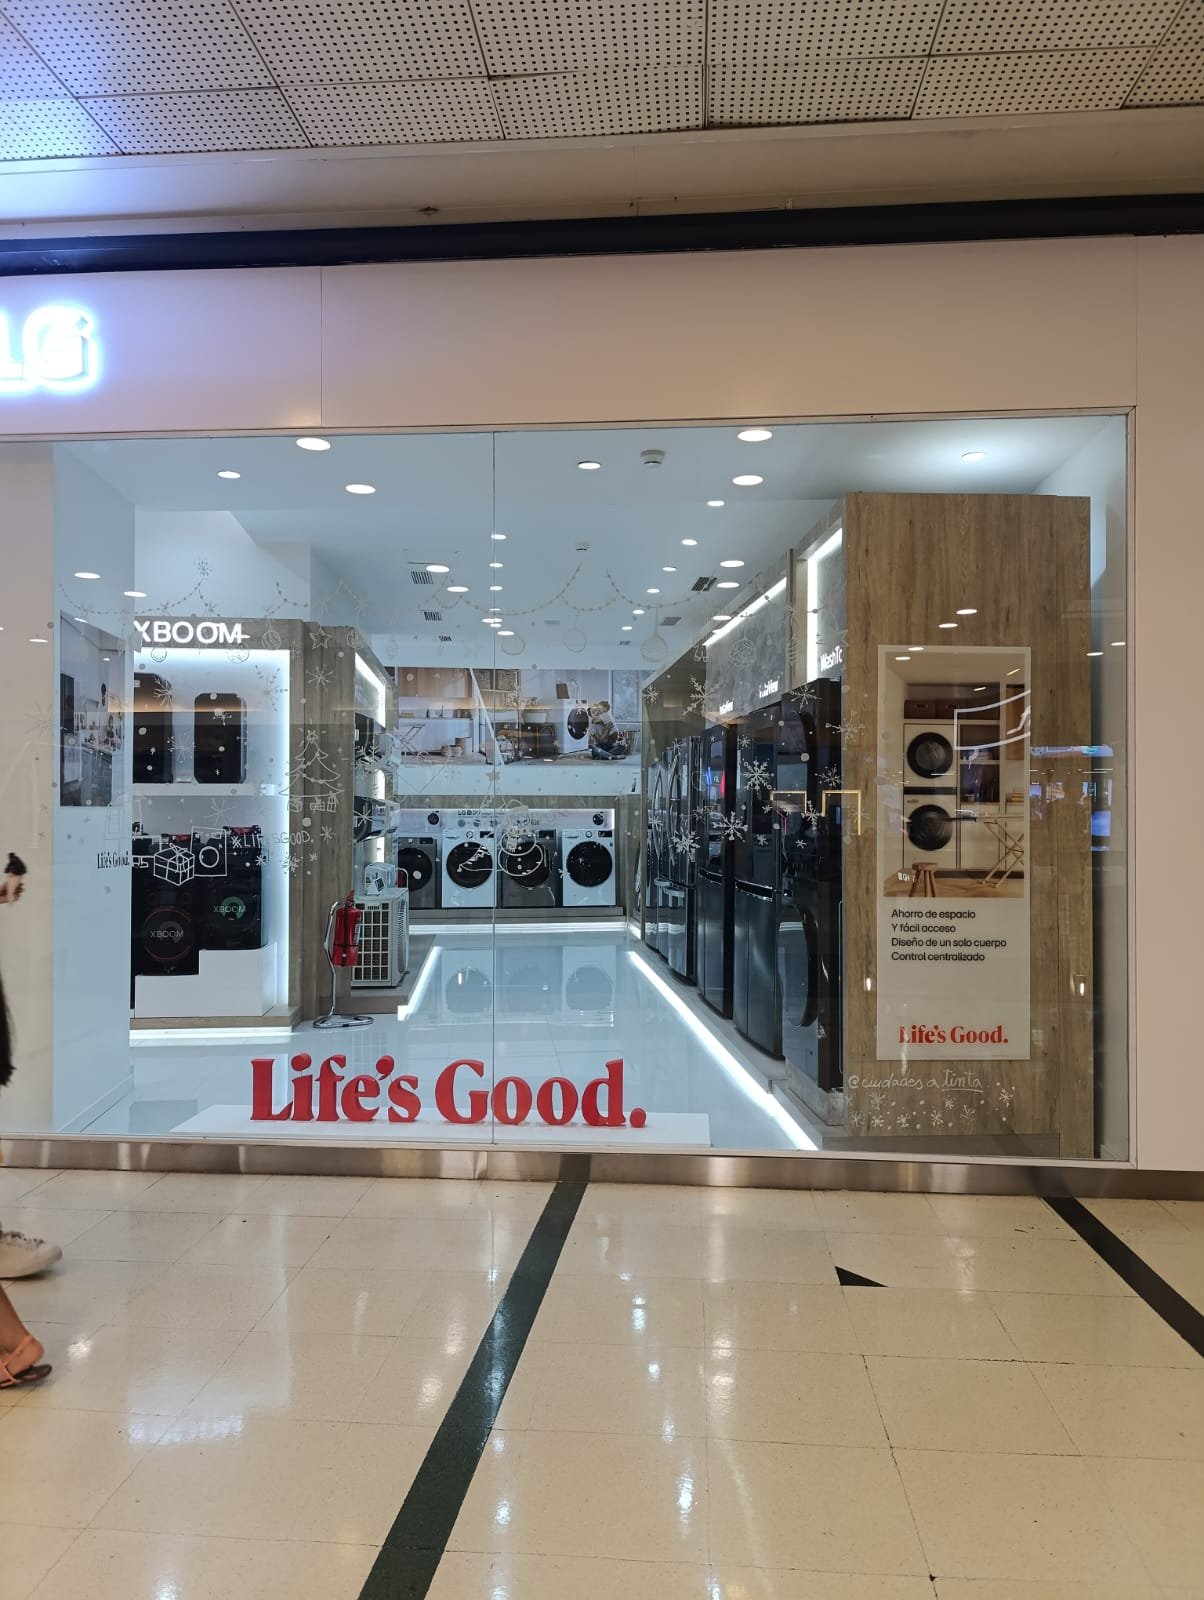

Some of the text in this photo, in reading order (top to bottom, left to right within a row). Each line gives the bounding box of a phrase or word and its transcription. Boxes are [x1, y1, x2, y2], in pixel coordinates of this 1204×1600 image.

[133, 620, 243, 645] XBOOM
[212, 905, 247, 913] XBOOM
[891, 909, 976, 921] Ahorro de espacio
[150, 930, 184, 938] XBOOM
[891, 923, 956, 933] Y fácil acceso
[891, 936, 1007, 949] Diseño de un solo cuerpo
[891, 952, 985, 961] Control centralizado
[950, 1025, 1009, 1044] Good.
[435, 1058, 647, 1129] Good.
